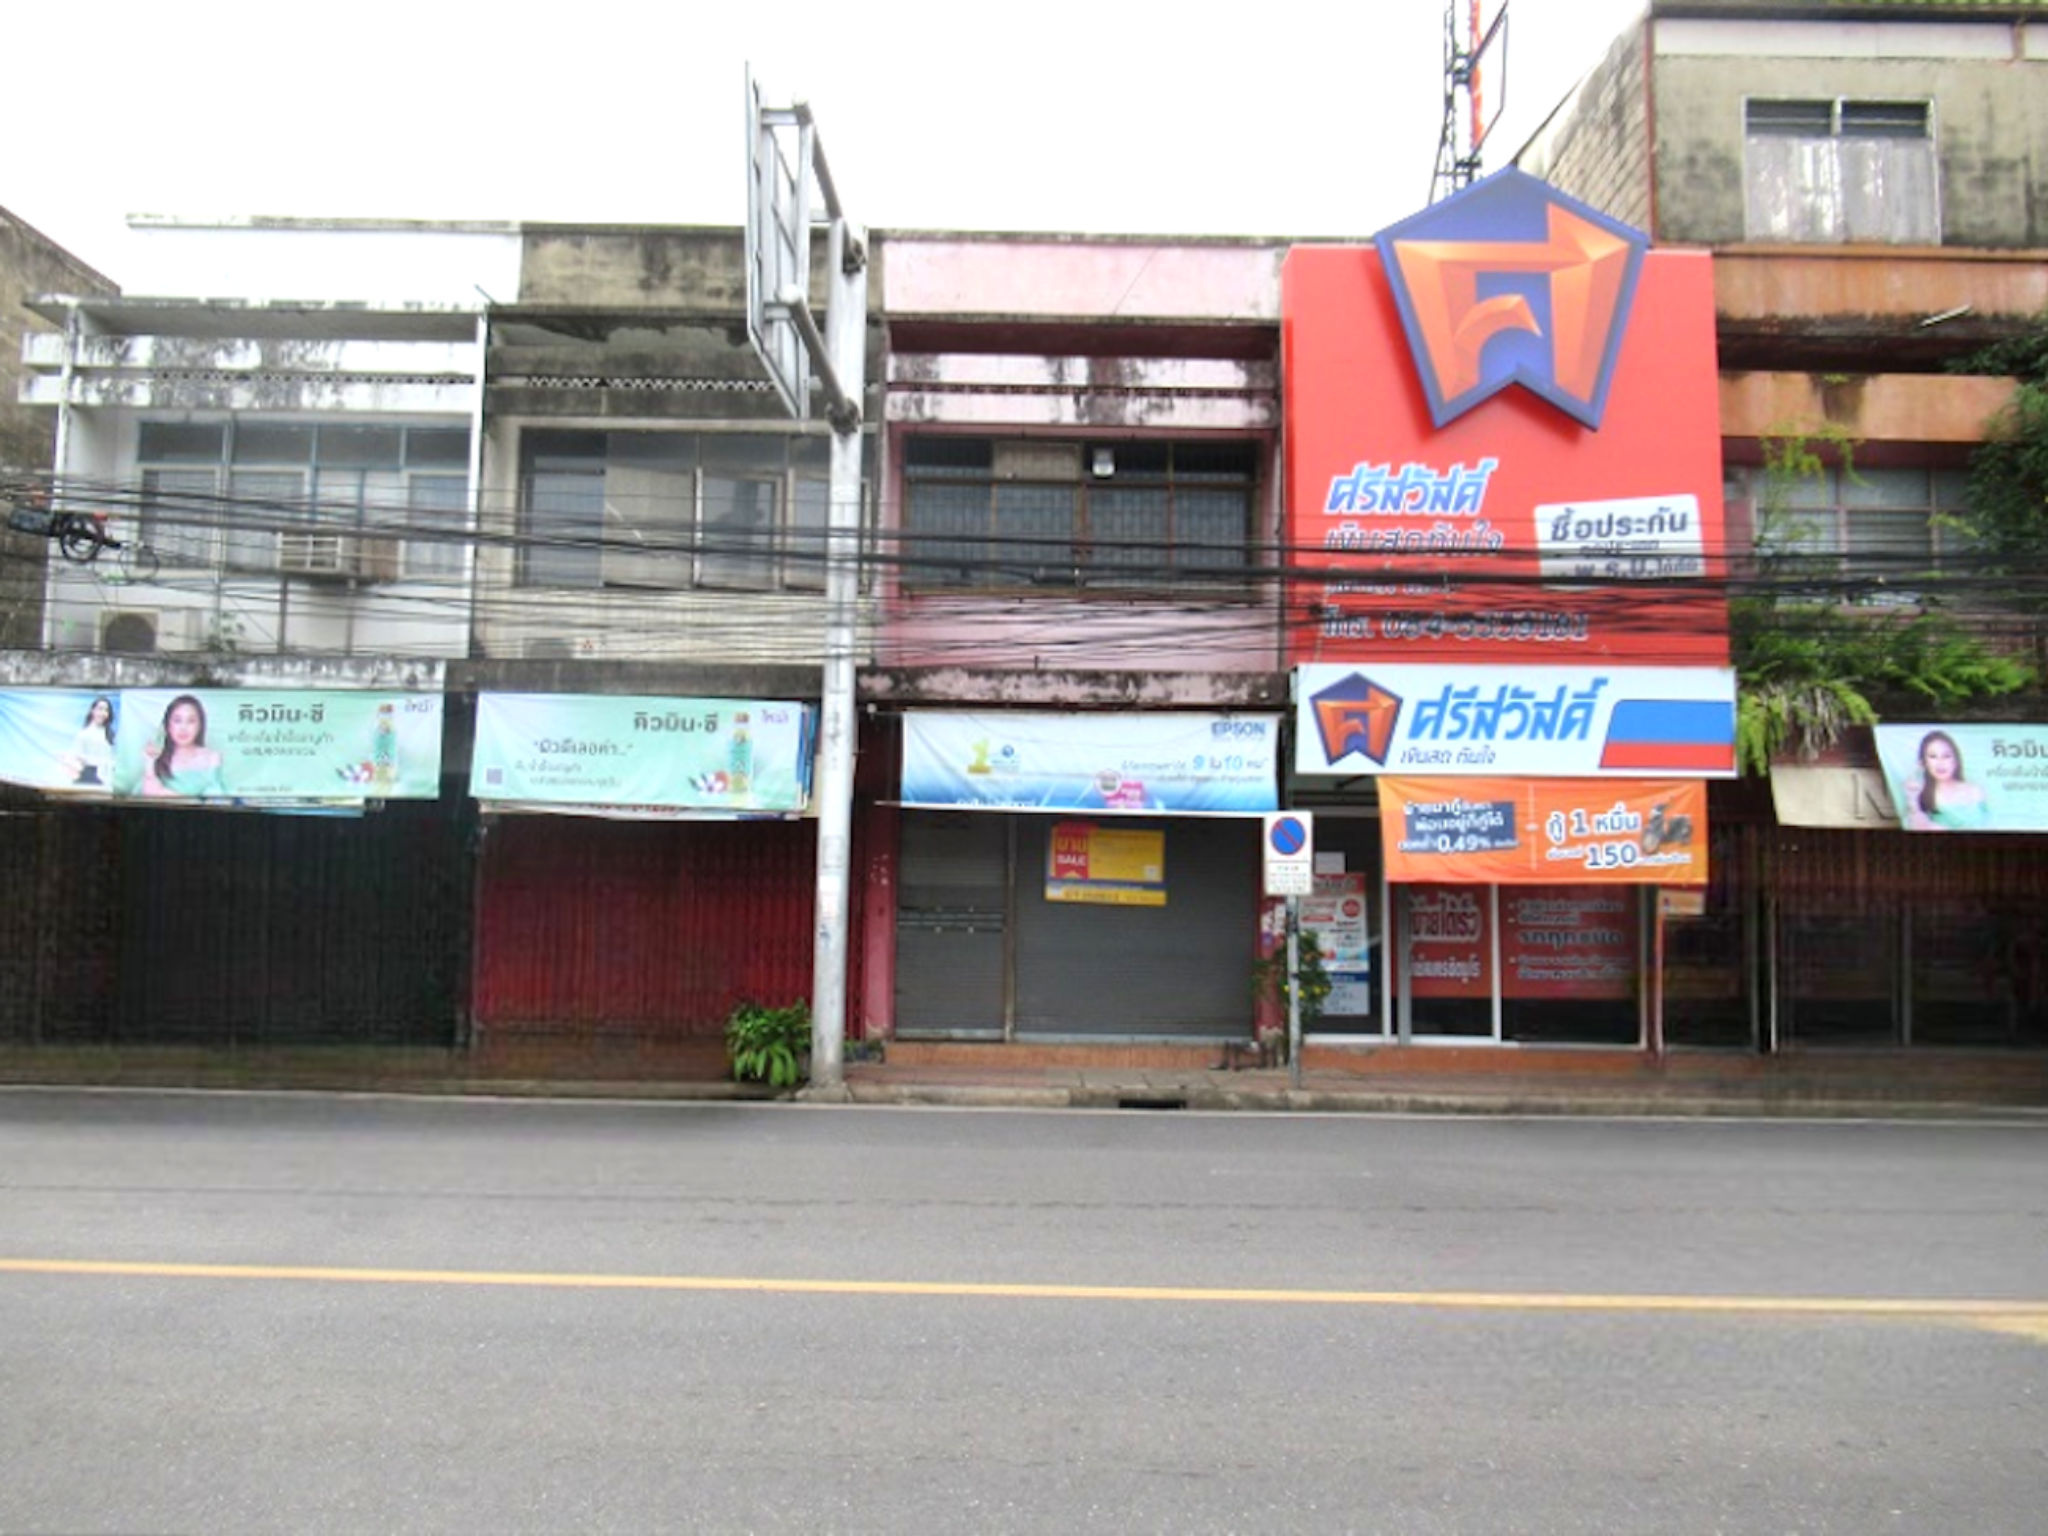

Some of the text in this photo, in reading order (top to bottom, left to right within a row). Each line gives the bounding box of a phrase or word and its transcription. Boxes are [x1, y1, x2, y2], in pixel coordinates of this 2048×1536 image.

[1326, 459, 1499, 514] ศรีสวัสดิ์
[1552, 508, 1688, 541] ซื้อประกัน
[1407, 677, 1609, 741] ศรีสวัสดิ์
[1211, 721, 1267, 737] EPSON
[1571, 810, 1589, 835] 1
[1594, 801, 1641, 833] หมื่น
[1587, 842, 1638, 868] 150
